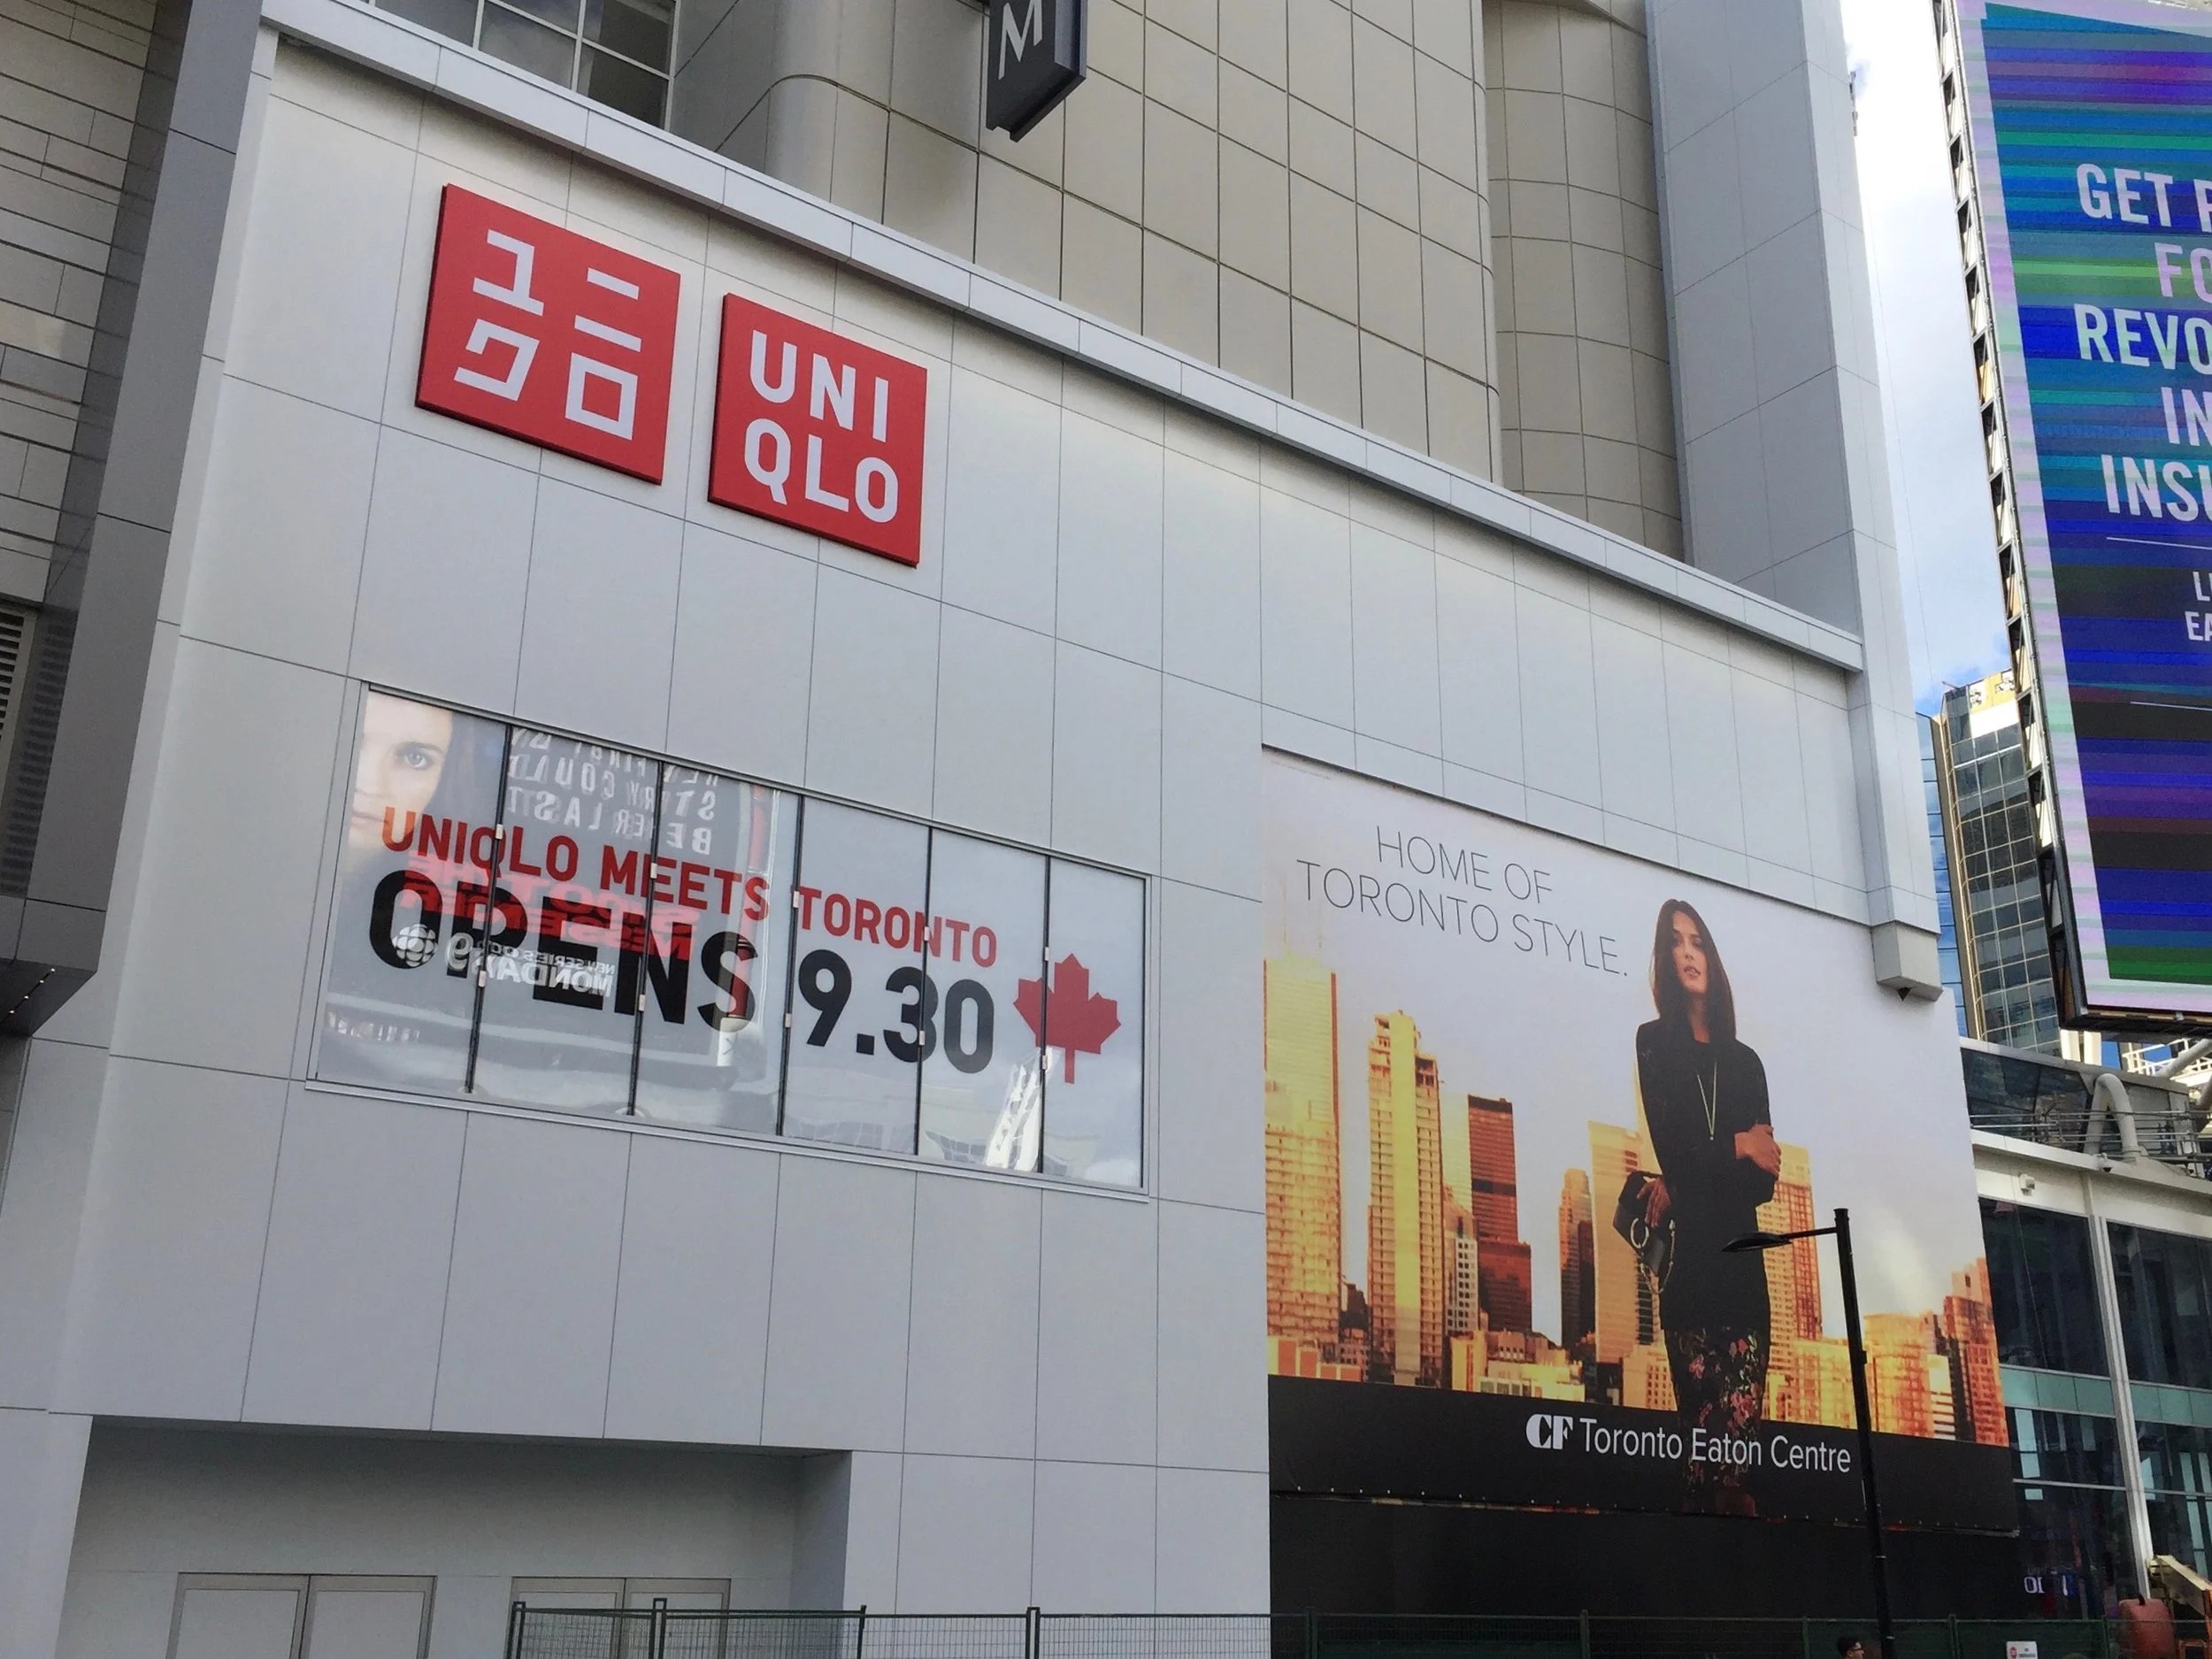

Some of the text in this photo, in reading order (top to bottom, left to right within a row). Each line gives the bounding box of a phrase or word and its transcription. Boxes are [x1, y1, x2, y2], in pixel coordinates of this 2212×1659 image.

[998, 0, 1042, 81] M
[2077, 163, 2173, 227] GET
[2074, 303, 2212, 375] REVO
[749, 330, 889, 442] UNI
[744, 418, 899, 523] QLO
[381, 807, 997, 968] UNIQLO MEETS TORONTO
[1377, 826, 1553, 903] HOME OF
[1296, 859, 1628, 977] TORONTO STYLE.
[369, 870, 995, 1073] OPENS 9.30
[1525, 1413, 1851, 1473] CF Toronto Eaton Centre
